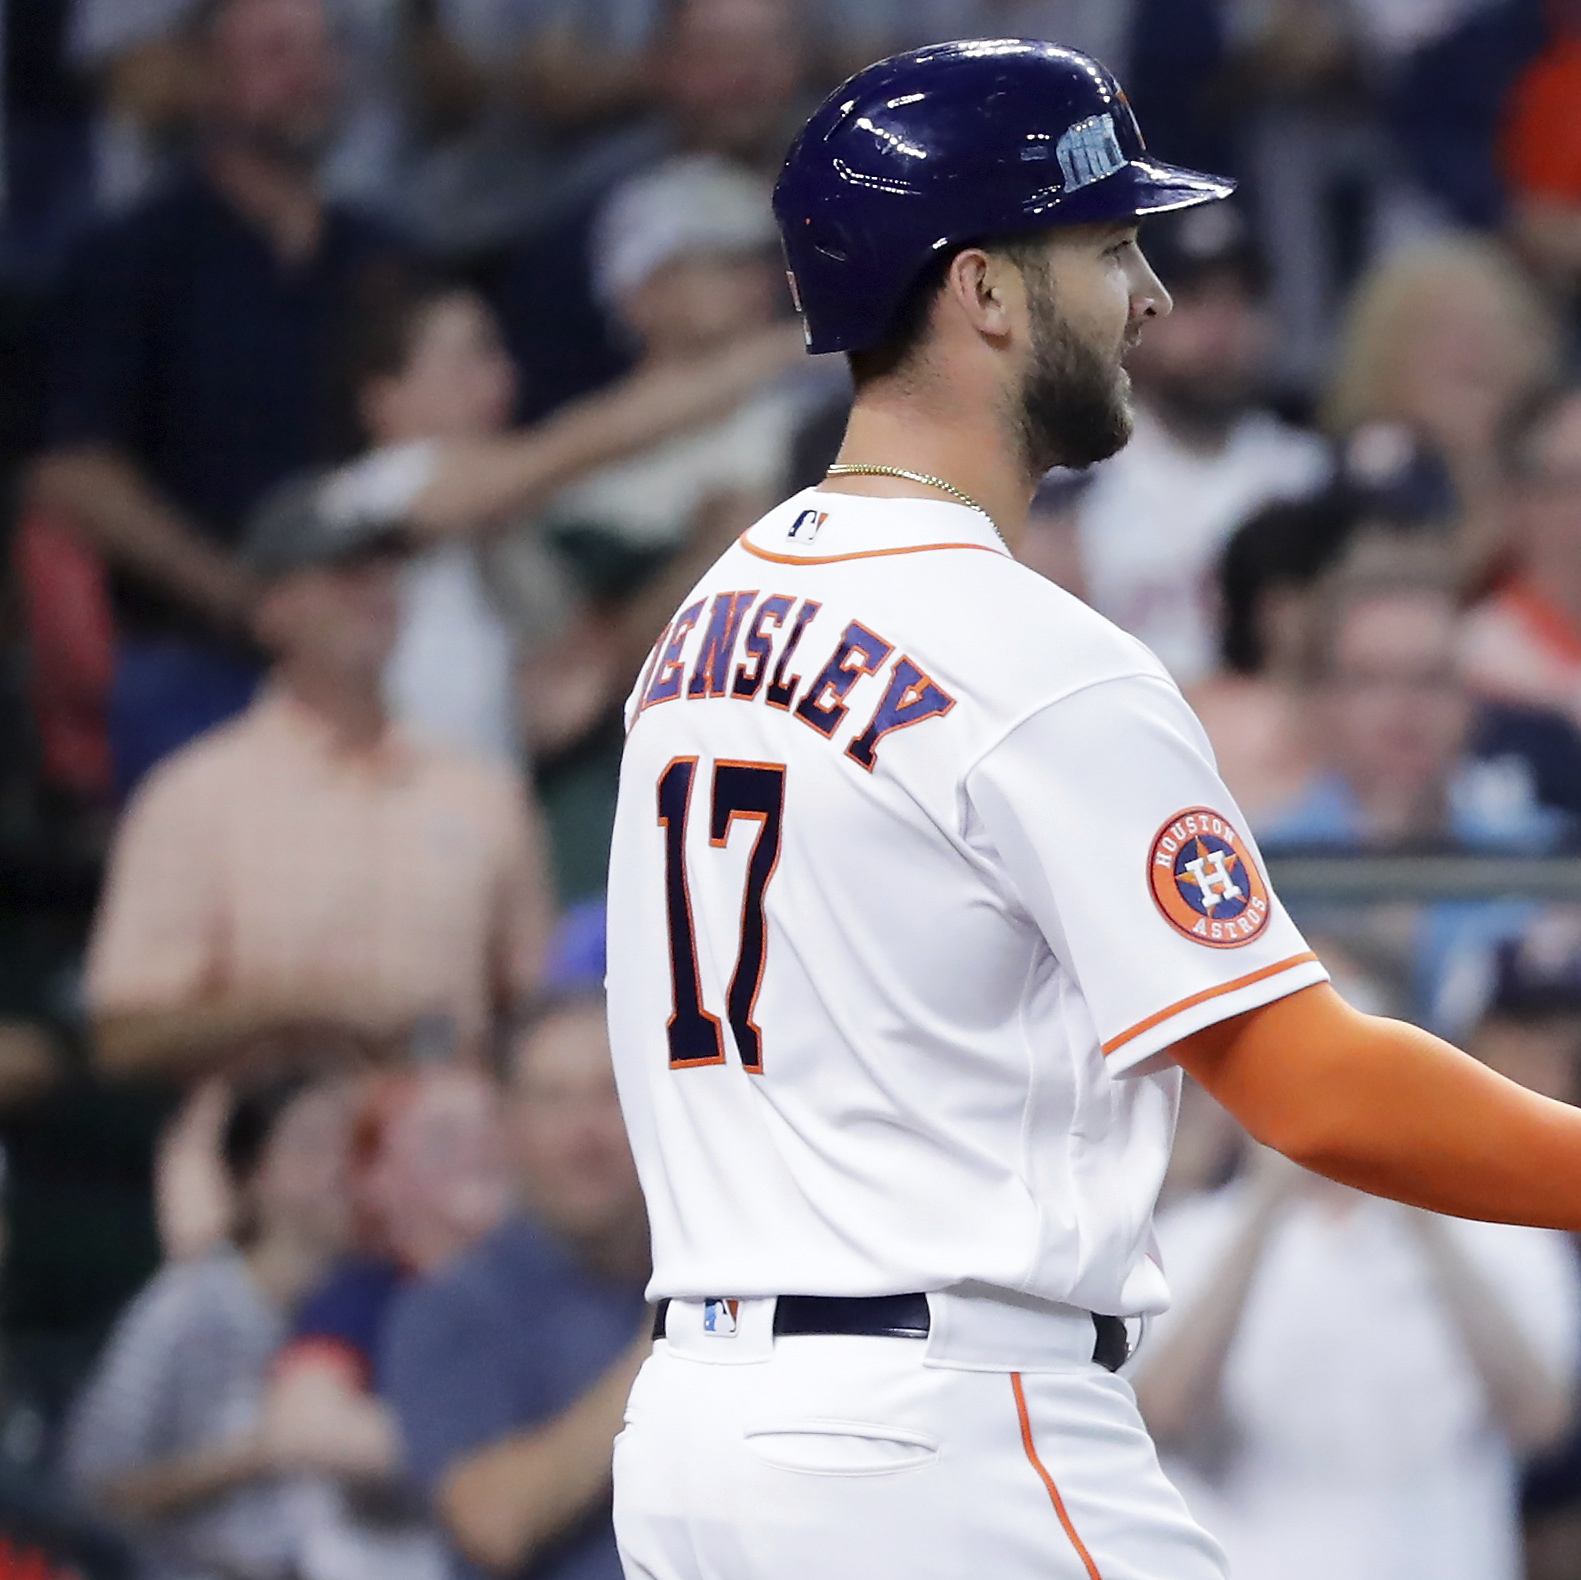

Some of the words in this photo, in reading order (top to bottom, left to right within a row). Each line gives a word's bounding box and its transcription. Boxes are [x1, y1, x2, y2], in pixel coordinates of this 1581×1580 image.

[627, 590, 957, 773] ENSLEY
[1155, 814, 1236, 868] HOUSTON
[1184, 849, 1243, 908] H
[657, 755, 787, 1074] 17
[1192, 896, 1267, 939] ASTROS
